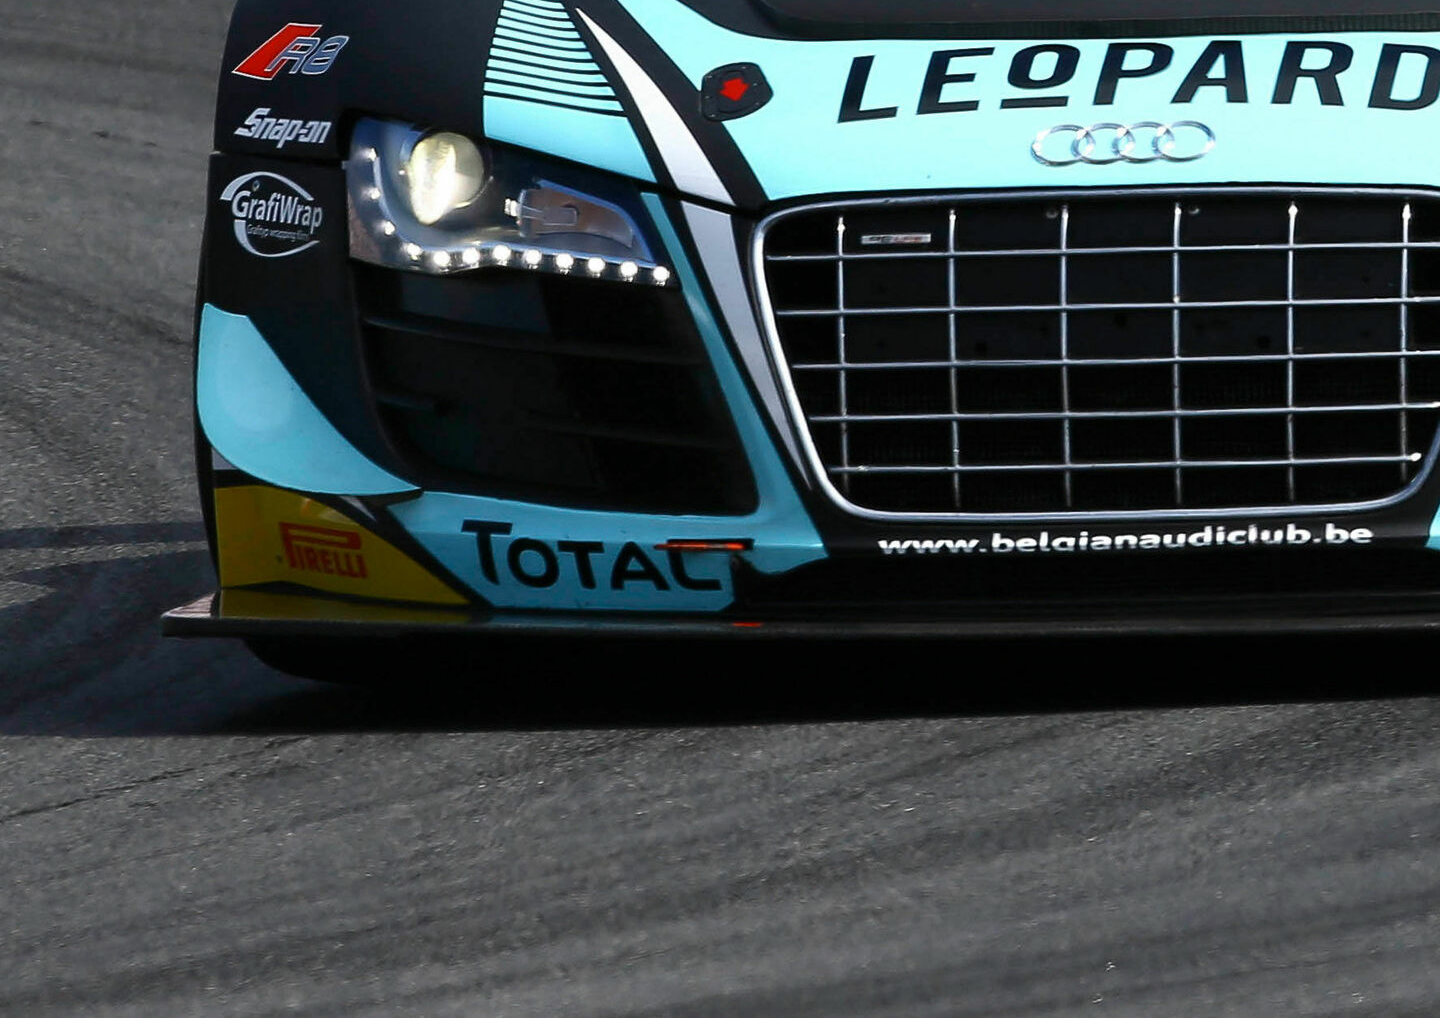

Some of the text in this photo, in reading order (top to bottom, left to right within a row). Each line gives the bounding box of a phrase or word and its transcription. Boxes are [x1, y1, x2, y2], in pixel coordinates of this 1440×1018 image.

[264, 35, 350, 76] R8
[234, 107, 332, 149] Snap-on
[231, 190, 324, 235] GrafiWrap
[278, 521, 368, 579] PIRELLI
[460, 518, 724, 593] TOTAL
